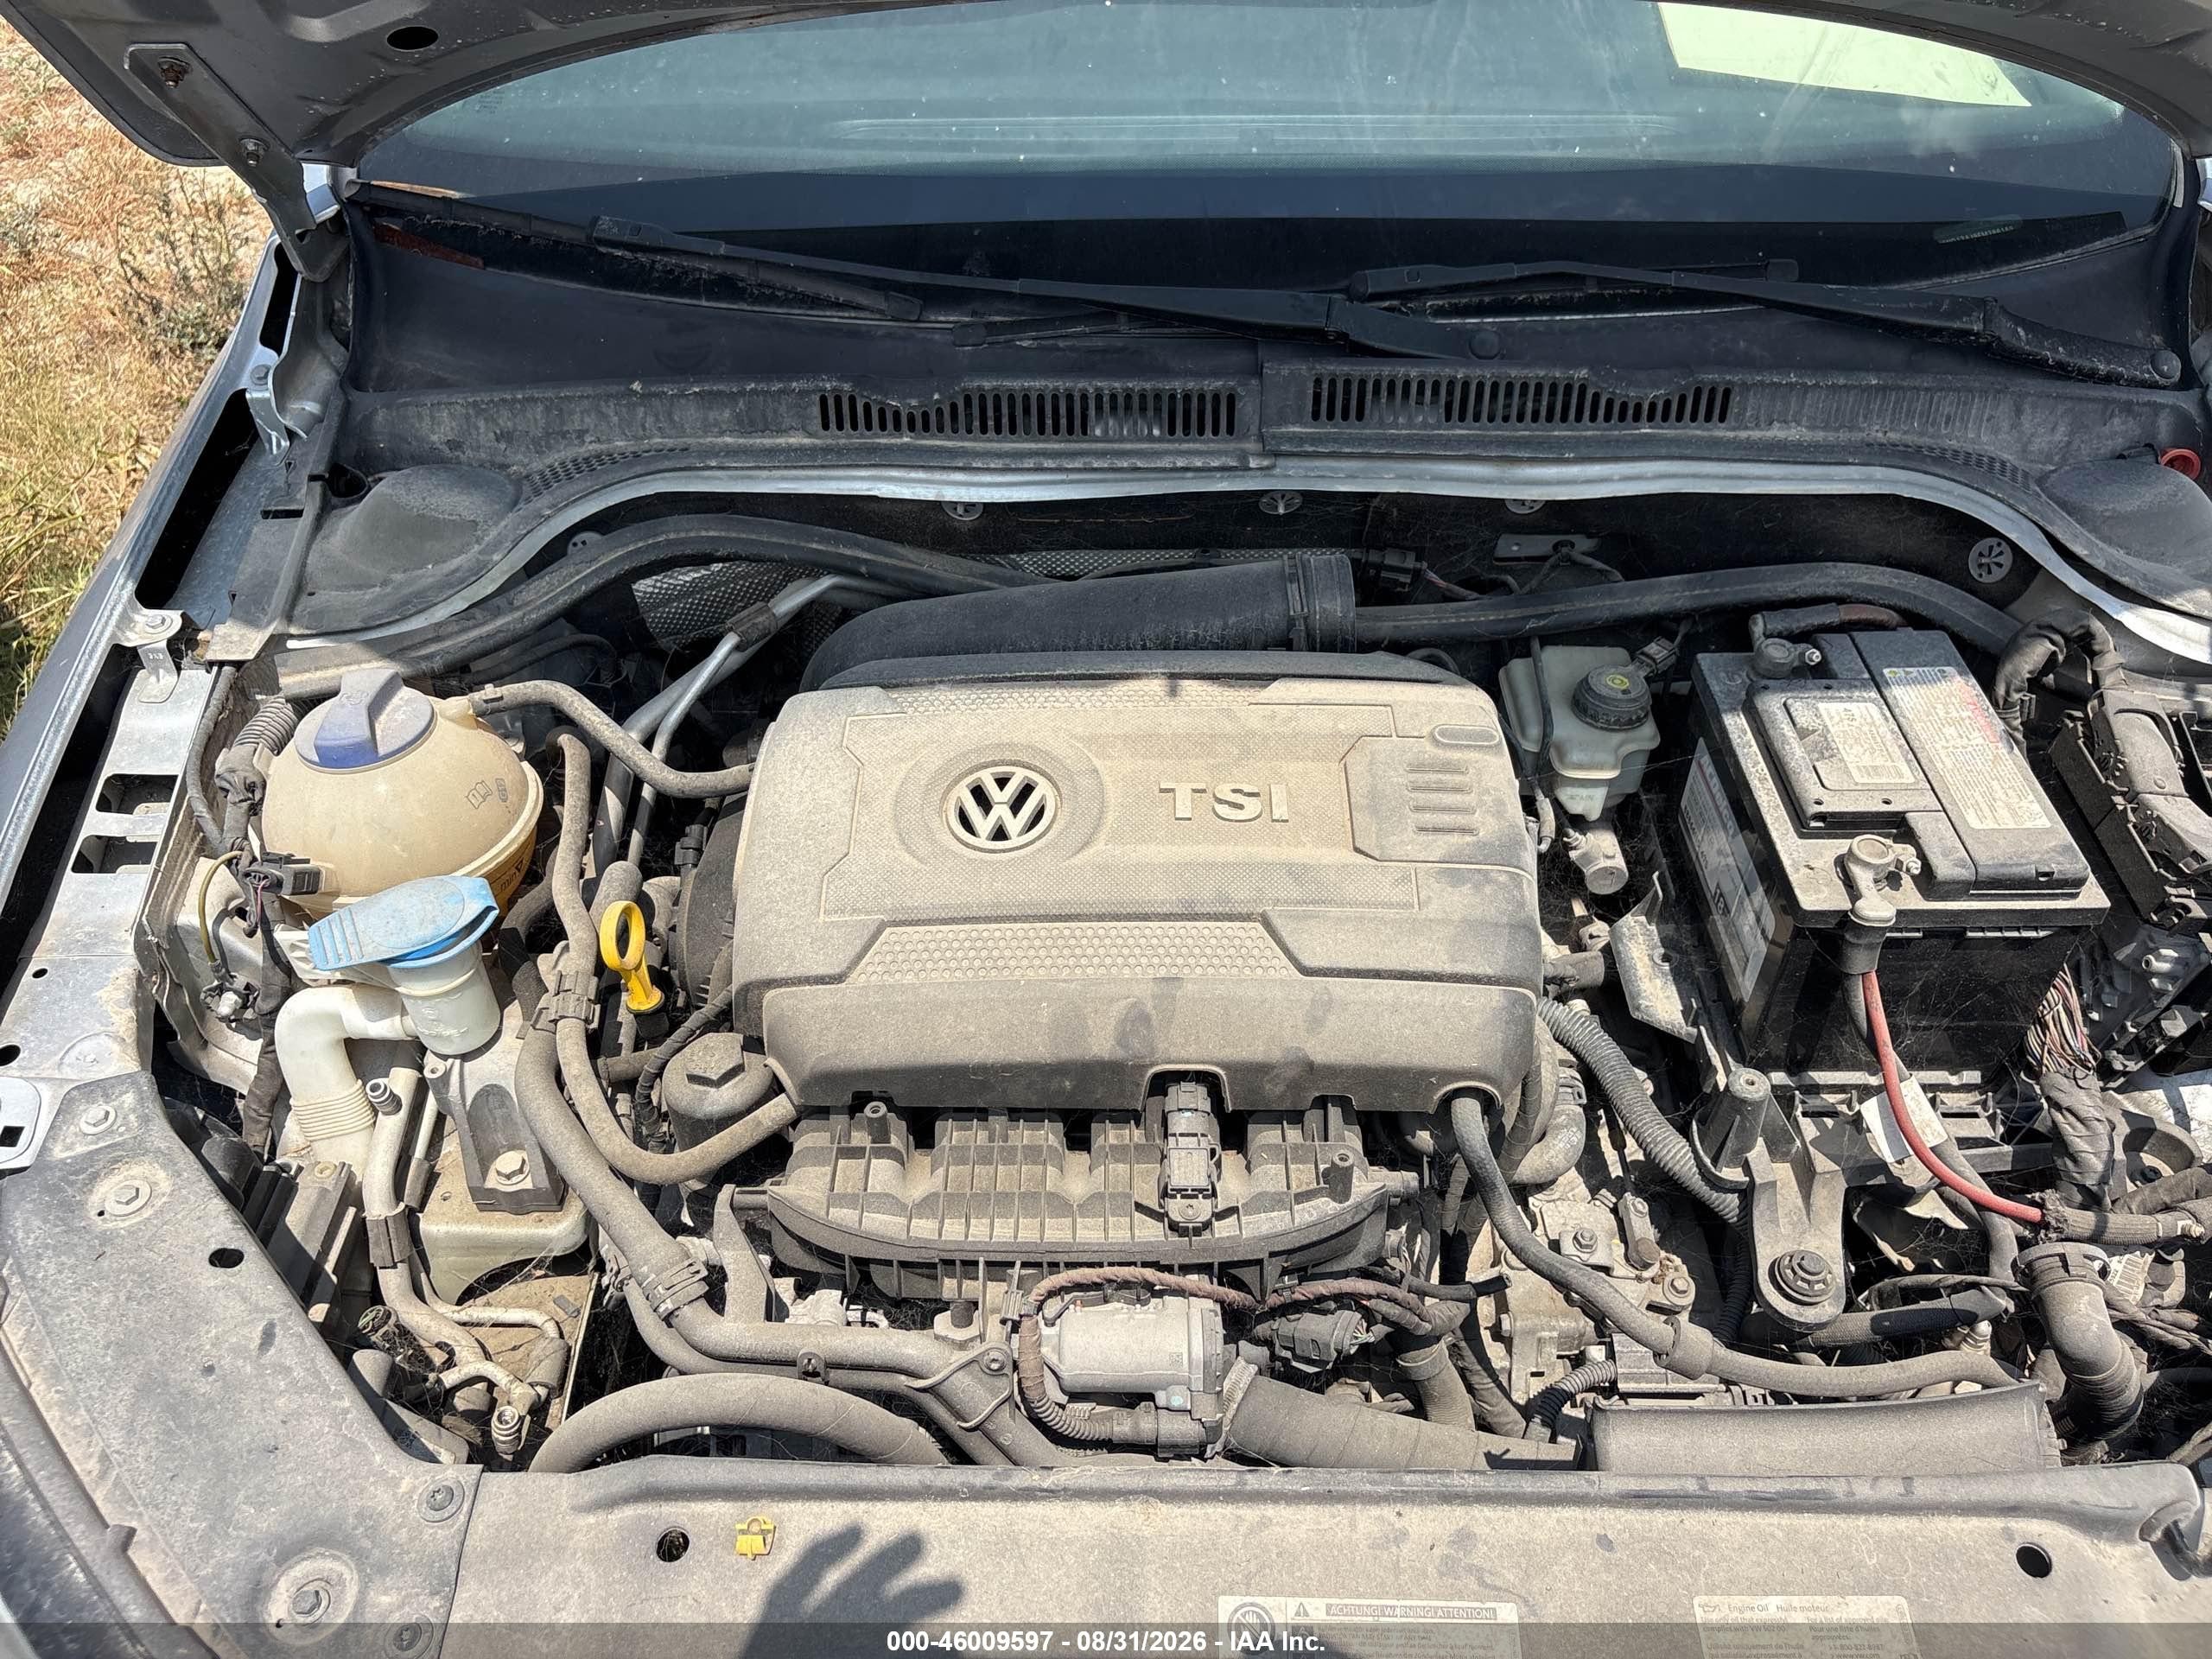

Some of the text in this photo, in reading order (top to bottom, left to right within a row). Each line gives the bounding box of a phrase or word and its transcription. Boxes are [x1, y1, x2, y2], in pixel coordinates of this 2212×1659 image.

[1159, 782, 1290, 823] TSI
[499, 869, 518, 893] min
[1331, 1605, 1493, 1619] ACHTUNG! WARNING! ATTENTION!
[1728, 1604, 1769, 1615] Engine Oil
[1776, 1604, 1798, 1612] Huile
